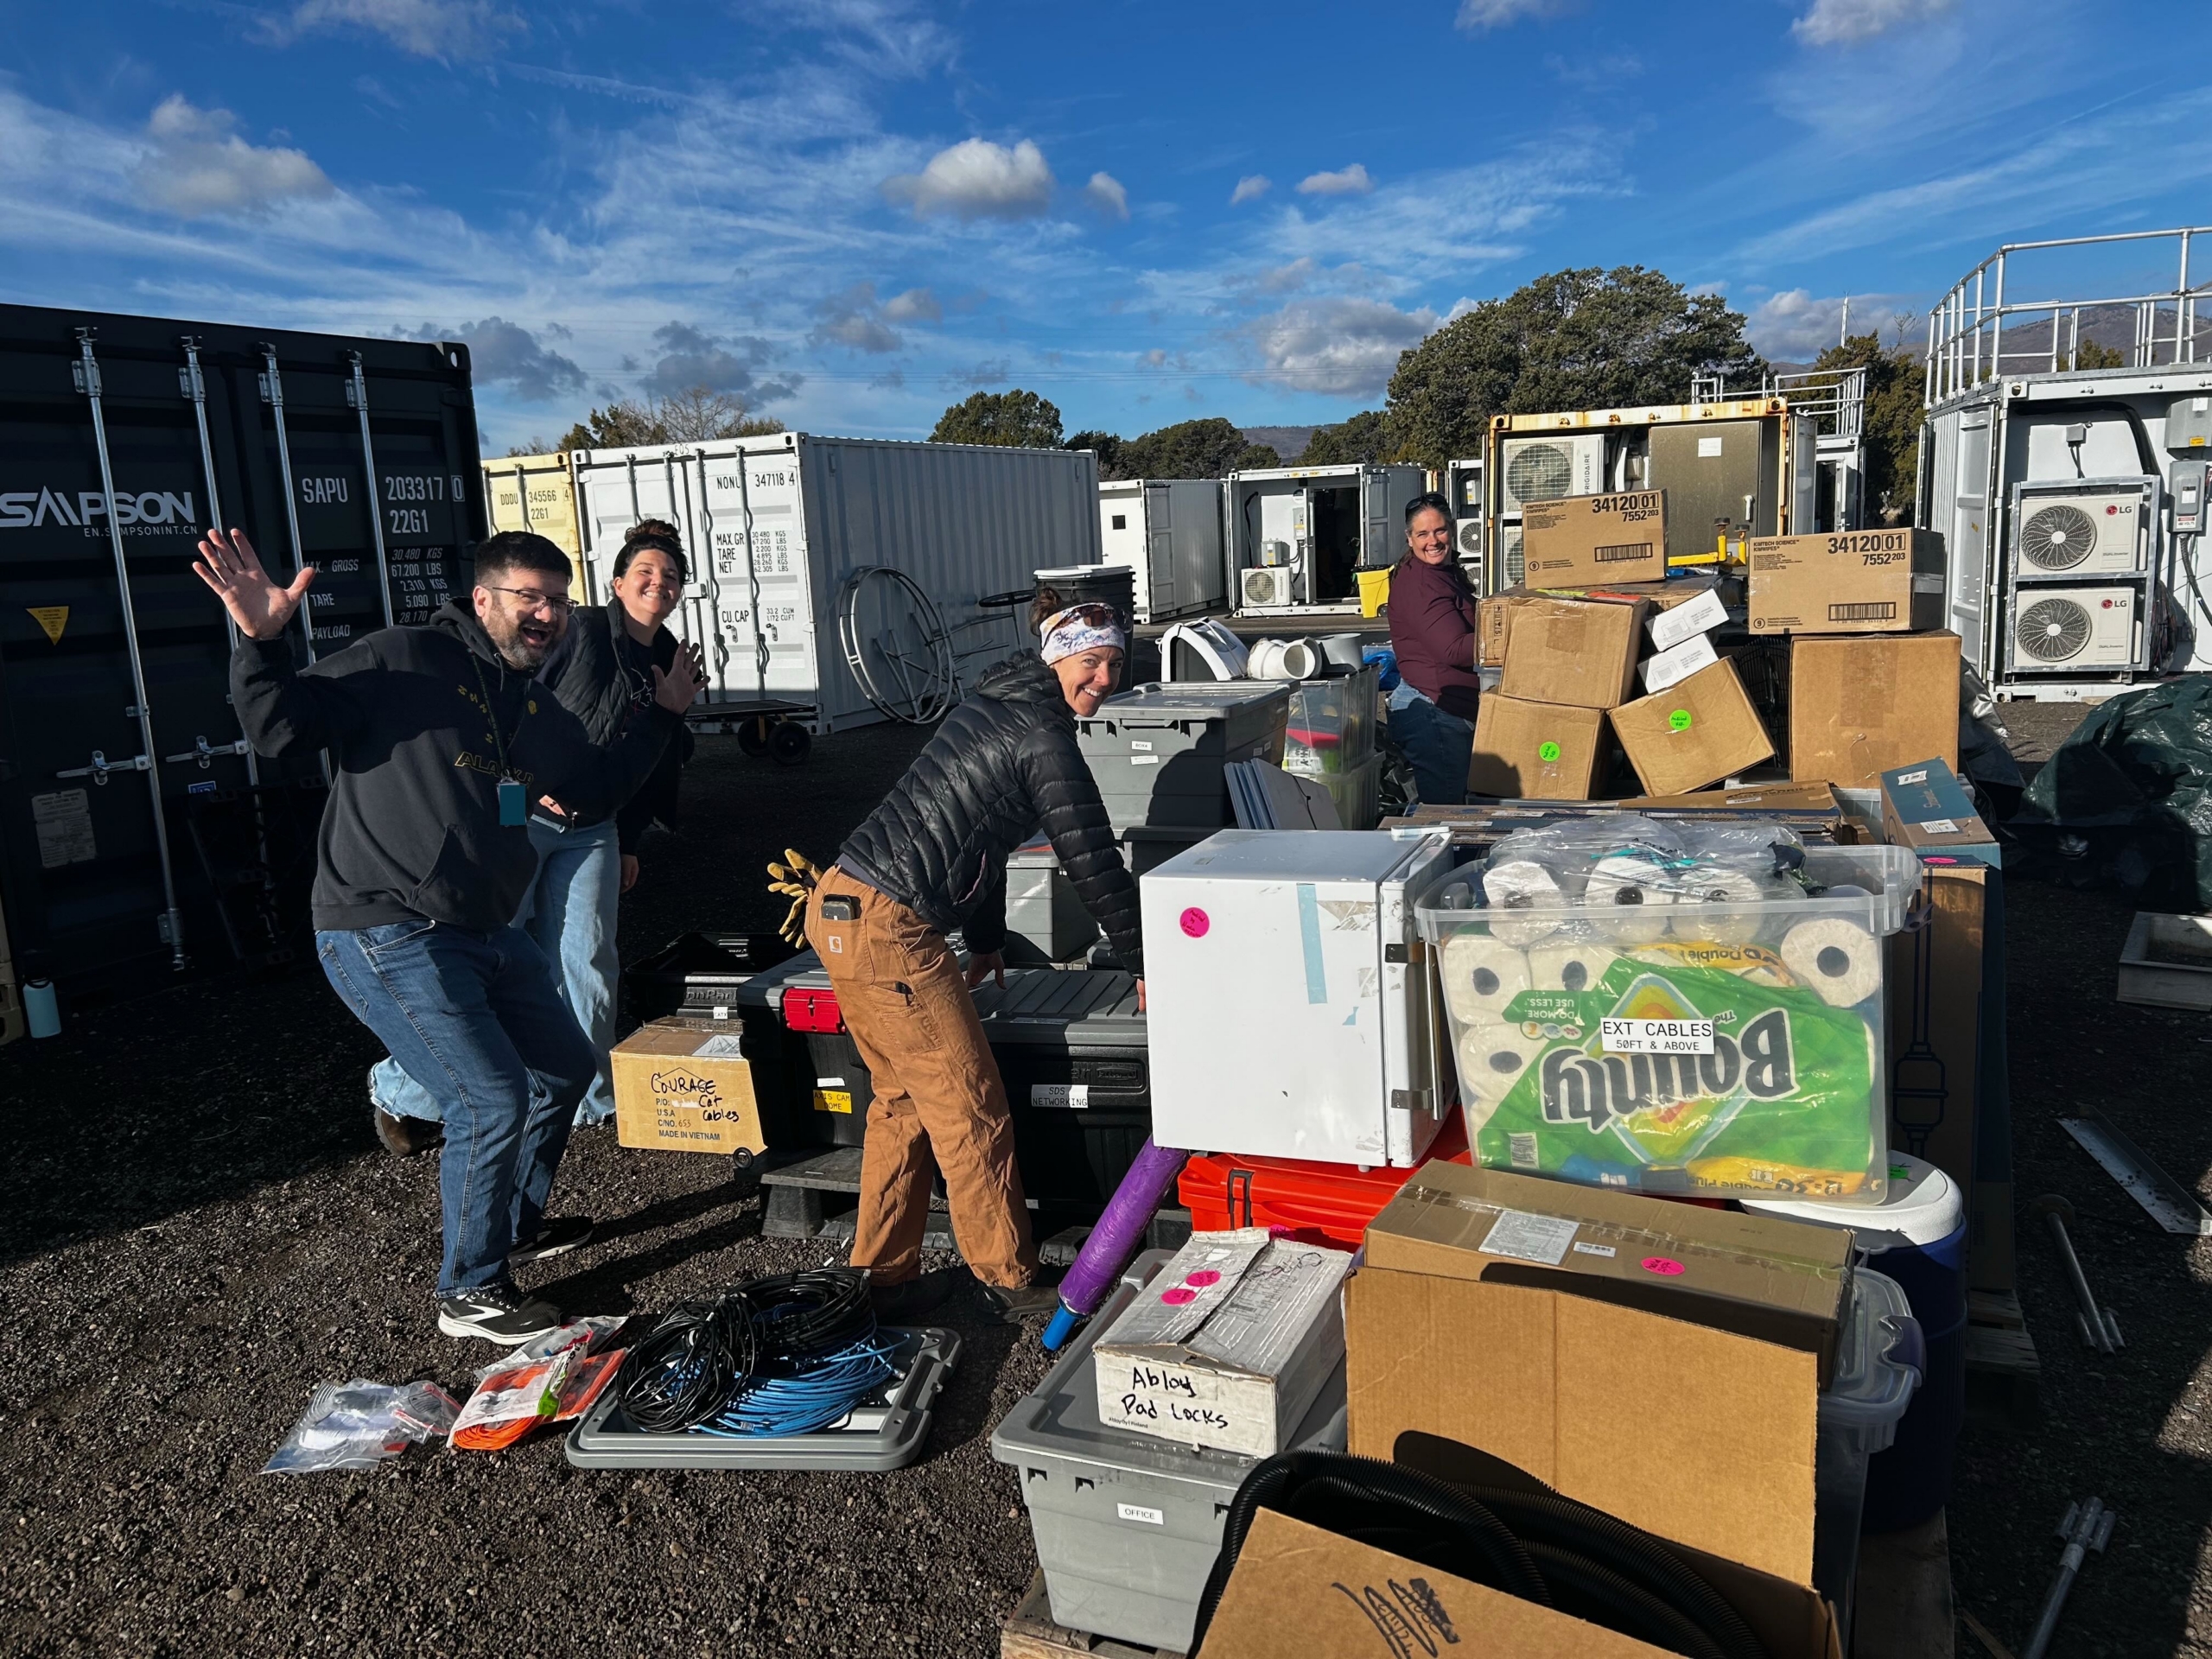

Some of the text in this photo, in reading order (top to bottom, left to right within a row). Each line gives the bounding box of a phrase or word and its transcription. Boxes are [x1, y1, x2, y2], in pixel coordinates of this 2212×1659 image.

[755, 473, 784, 487] 347118
[302, 478, 348, 503] SAPU
[385, 477, 443, 500] 203317
[500, 493, 518, 505] DDDU
[529, 489, 557, 503] 345566
[1592, 495, 1638, 514] 34120
[390, 510, 429, 533] 22G1
[1622, 510, 1647, 522] 7552
[84, 526, 198, 537] EN.SMPSONINT.CN
[1828, 535, 1881, 554] 34120
[426, 548, 443, 559] KGS
[717, 548, 736, 560] TARE
[1862, 553, 1891, 566] 7552
[332, 559, 359, 572] GROSS
[426, 563, 442, 575] LBS
[719, 561, 732, 573] NET
[430, 578, 447, 590] KGS
[310, 593, 335, 607] TARE
[435, 594, 450, 606] LBS
[312, 625, 350, 640] PAYLOAD
[454, 752, 534, 786] ALAKA
[1555, 999, 1575, 1007] USE
[1561, 1009, 1575, 1019] DO
[1713, 1010, 1735, 1023] The
[1603, 1021, 1711, 1037] EXT CABLES
[1616, 1040, 1700, 1050] 50FT & ABOVE
[1541, 1008, 1799, 1132] Bounty
[699, 1094, 723, 1107] Cat
[1032, 1098, 1088, 1106] NETWORKING
[678, 1120, 691, 1128] 653
[689, 1132, 720, 1140] VIETNAM
[1133, 1367, 1197, 1398] Abloy
[1125, 1508, 1155, 1519] OFFICE
